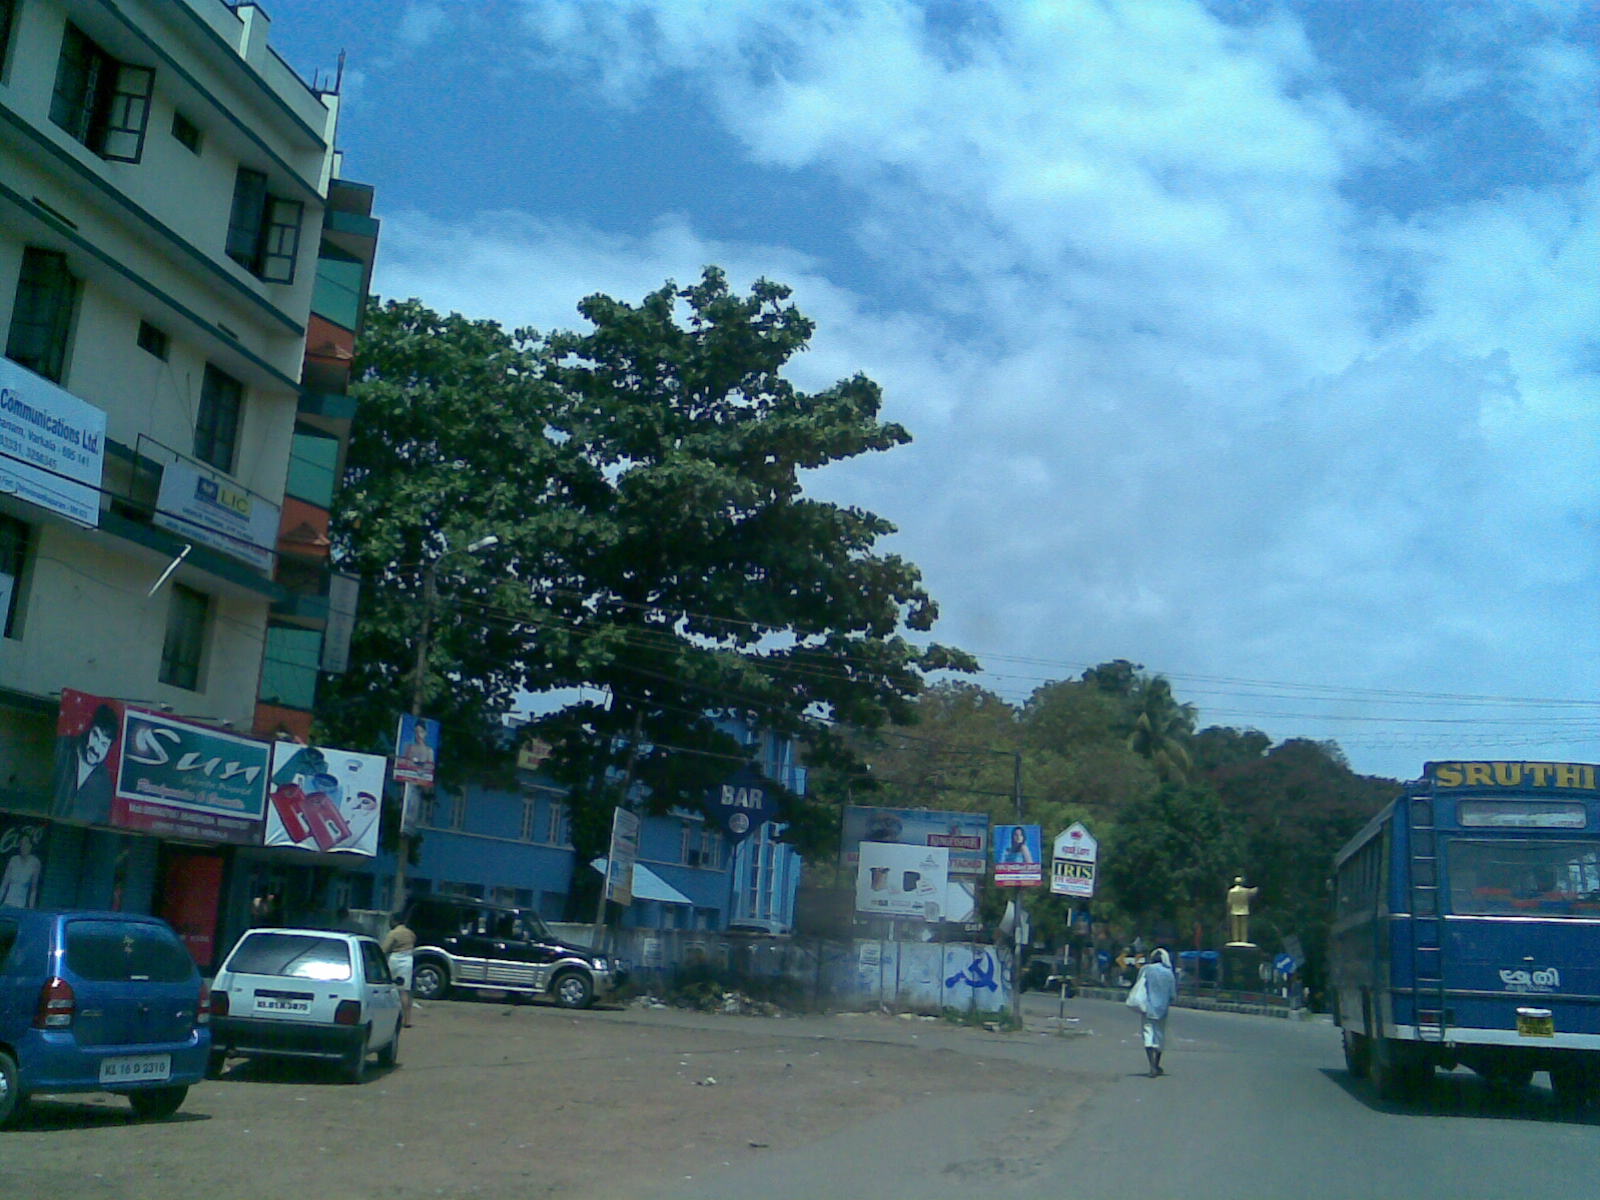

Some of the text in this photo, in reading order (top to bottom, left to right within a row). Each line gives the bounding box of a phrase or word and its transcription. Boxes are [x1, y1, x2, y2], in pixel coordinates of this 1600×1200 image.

[1, 388, 80, 445] Communications
[221, 489, 249, 513] LIC
[126, 728, 261, 785] Sun
[1435, 762, 1596, 790] SRUTHI
[720, 784, 763, 809] BAR
[1056, 863, 1092, 879] IRIS
